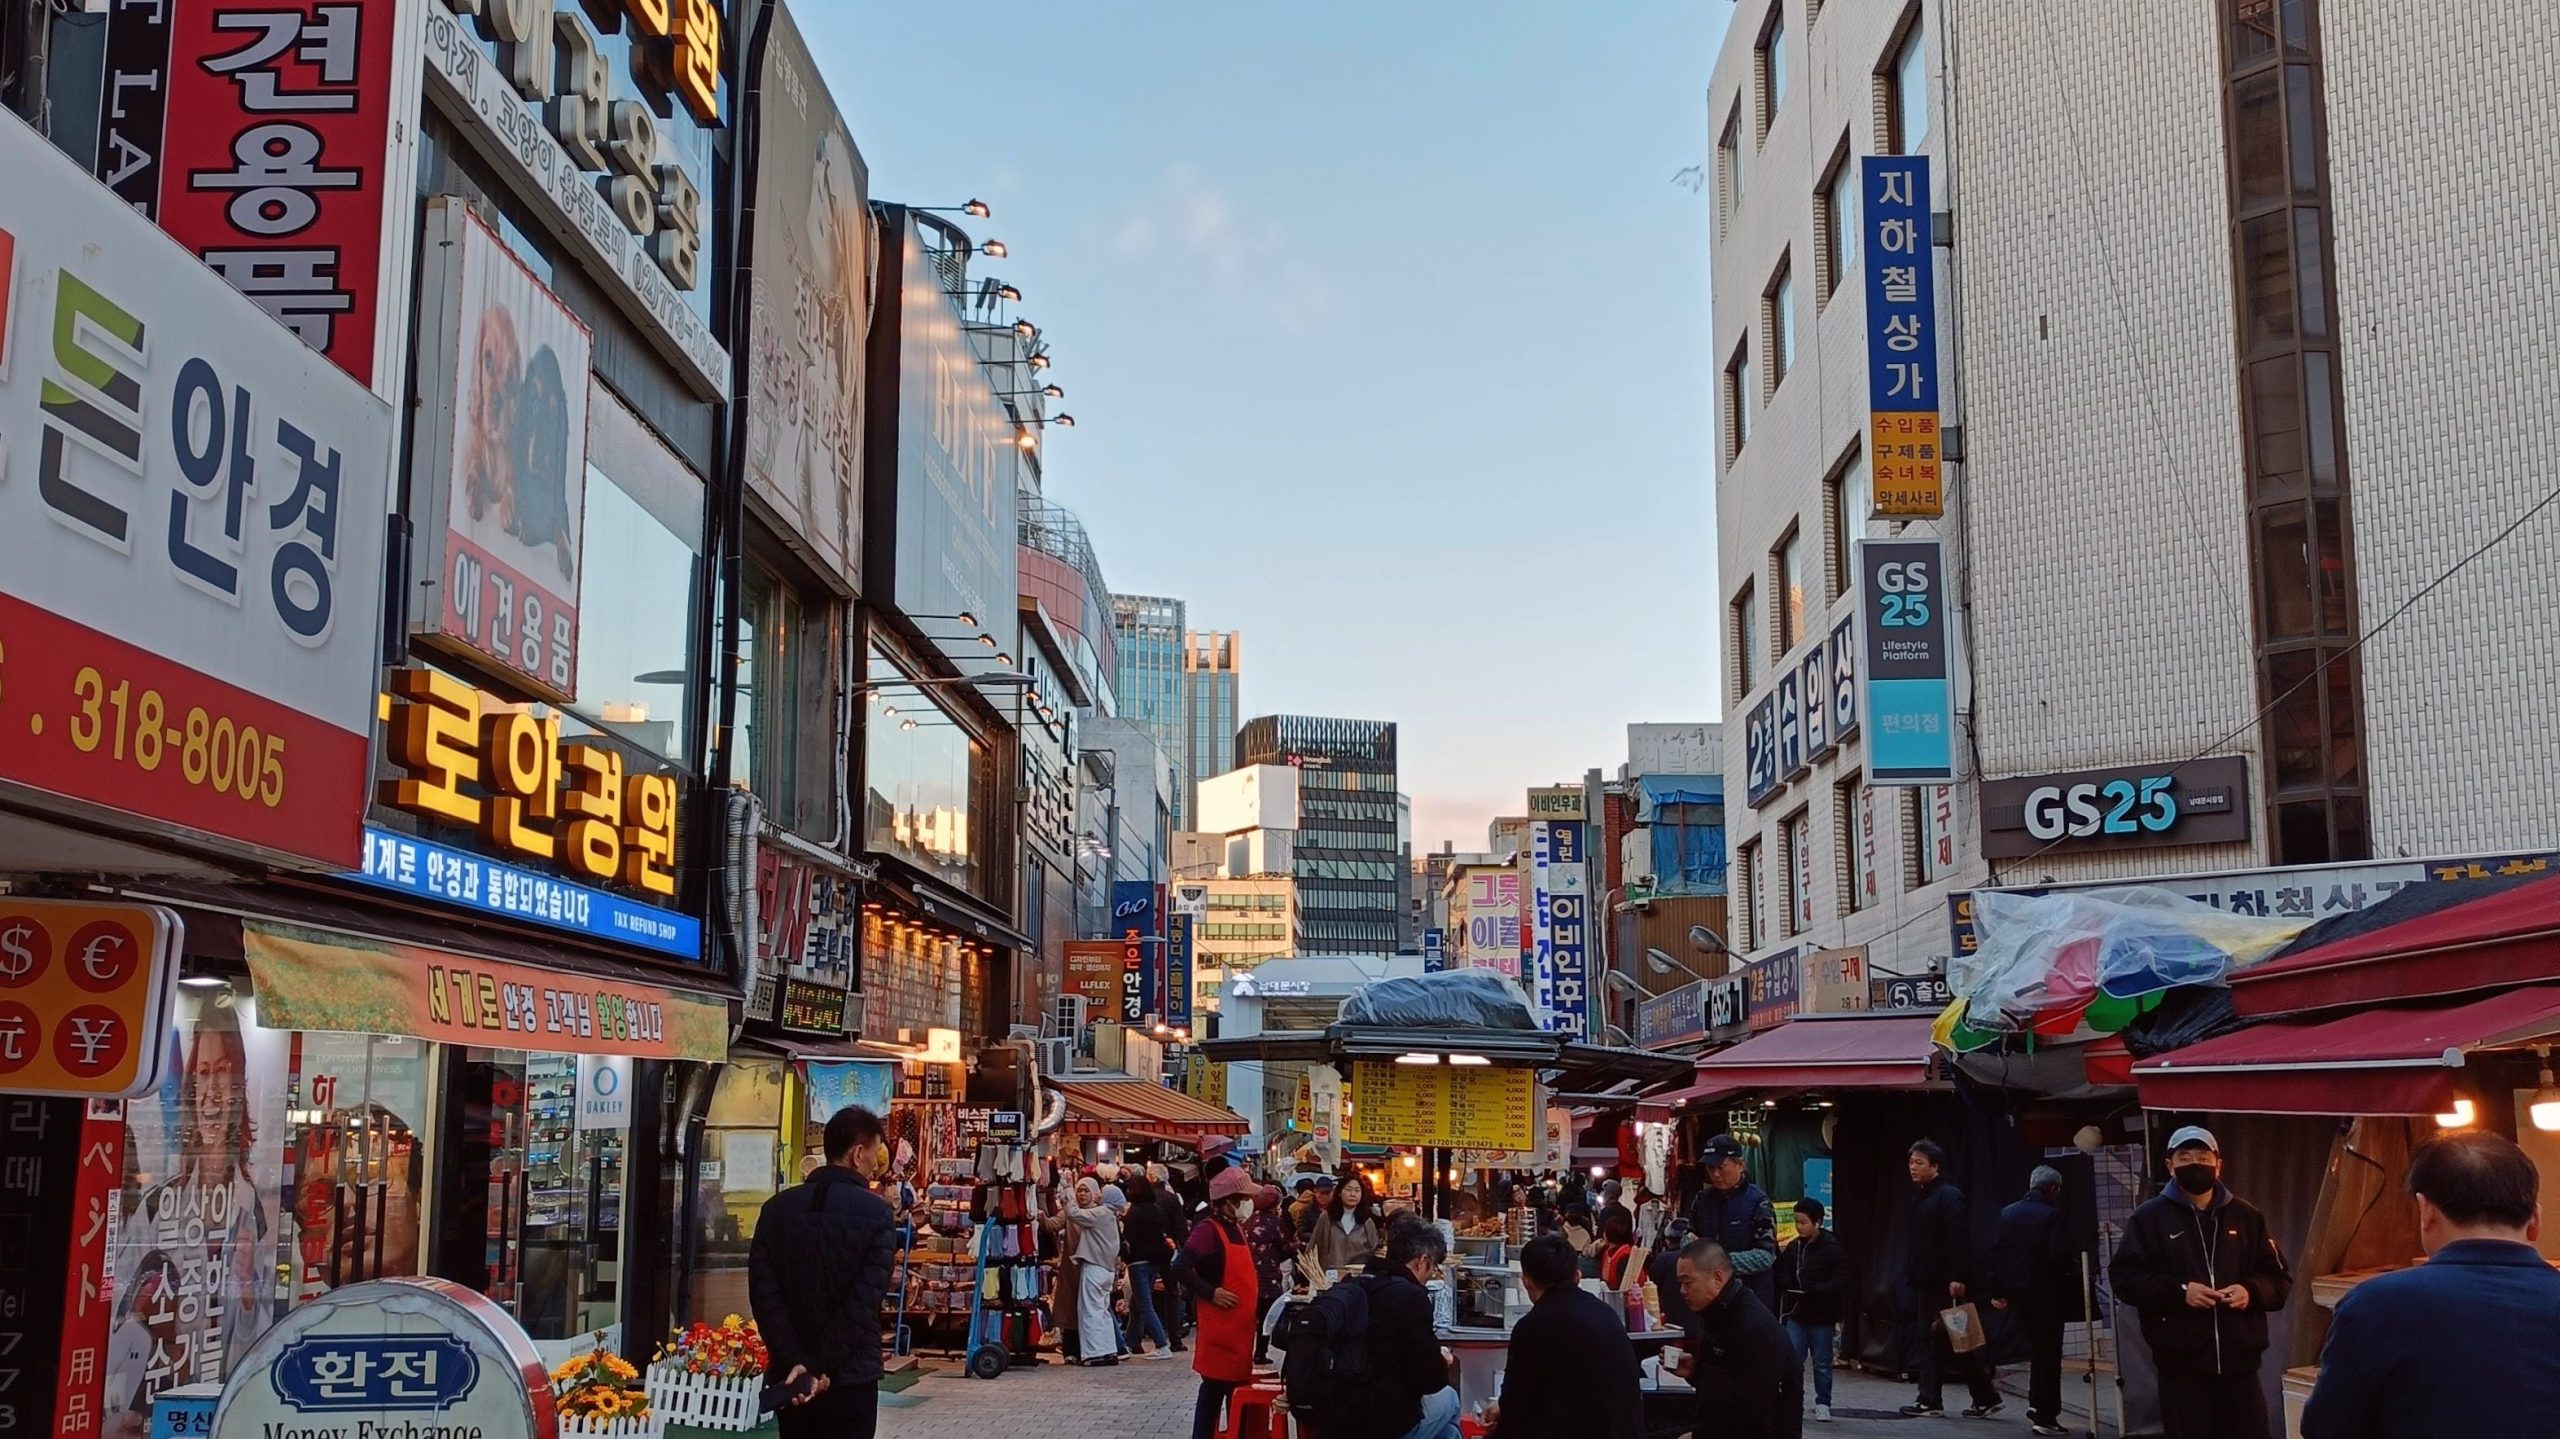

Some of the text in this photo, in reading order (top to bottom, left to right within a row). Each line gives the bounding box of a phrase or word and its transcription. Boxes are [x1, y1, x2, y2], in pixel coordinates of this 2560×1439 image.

[496, 90, 555, 192] 고양이
[560, 163, 626, 275] 용품도매
[632, 252, 724, 388] 02)773-1002
[1879, 171, 1923, 399] 지하철상가
[0, 229, 342, 637] 든안경
[1876, 417, 1935, 434] 수입품
[1877, 443, 1935, 460] 구제품
[1877, 465, 1936, 482] 숙녀복
[1879, 489, 1937, 506] 악세사리
[1877, 561, 1929, 593] GS
[453, 551, 572, 688] 애견용품
[1880, 594, 1930, 627] 25
[1882, 640, 1929, 651] Lifestyle
[1882, 650, 1930, 661] Platform
[70, 665, 286, 808] 318-8005
[1881, 713, 1940, 734] 편의점
[379, 670, 677, 896] 로안경원
[1530, 795, 1582, 813] 이비인후과
[2024, 776, 2177, 840] GS25
[1555, 829, 1574, 862] 열린
[1862, 787, 1877, 897] 수입구제
[427, 851, 479, 900] 안경과
[488, 867, 590, 927] 통합되었습니다
[613, 910, 627, 928] TAX
[630, 915, 656, 936] REFUND
[659, 922, 676, 940] SHOP
[1471, 874, 1519, 906] 그릇
[1800, 820, 1812, 922] 수입구제
[1471, 916, 1520, 949] 이불
[1259, 981, 1311, 992] 남대문시장
[1552, 898, 1586, 1037] 이비인후과
[503, 982, 537, 1033] 안경
[544, 988, 592, 1037] 고객님
[596, 992, 663, 1042] 환영합니다
[586, 1101, 622, 1114] OAKLEY
[157, 1181, 234, 1251] 일상의
[148, 1253, 229, 1325] 소중한
[145, 1326, 224, 1405] 순간들
[310, 1350, 438, 1399] 환전
